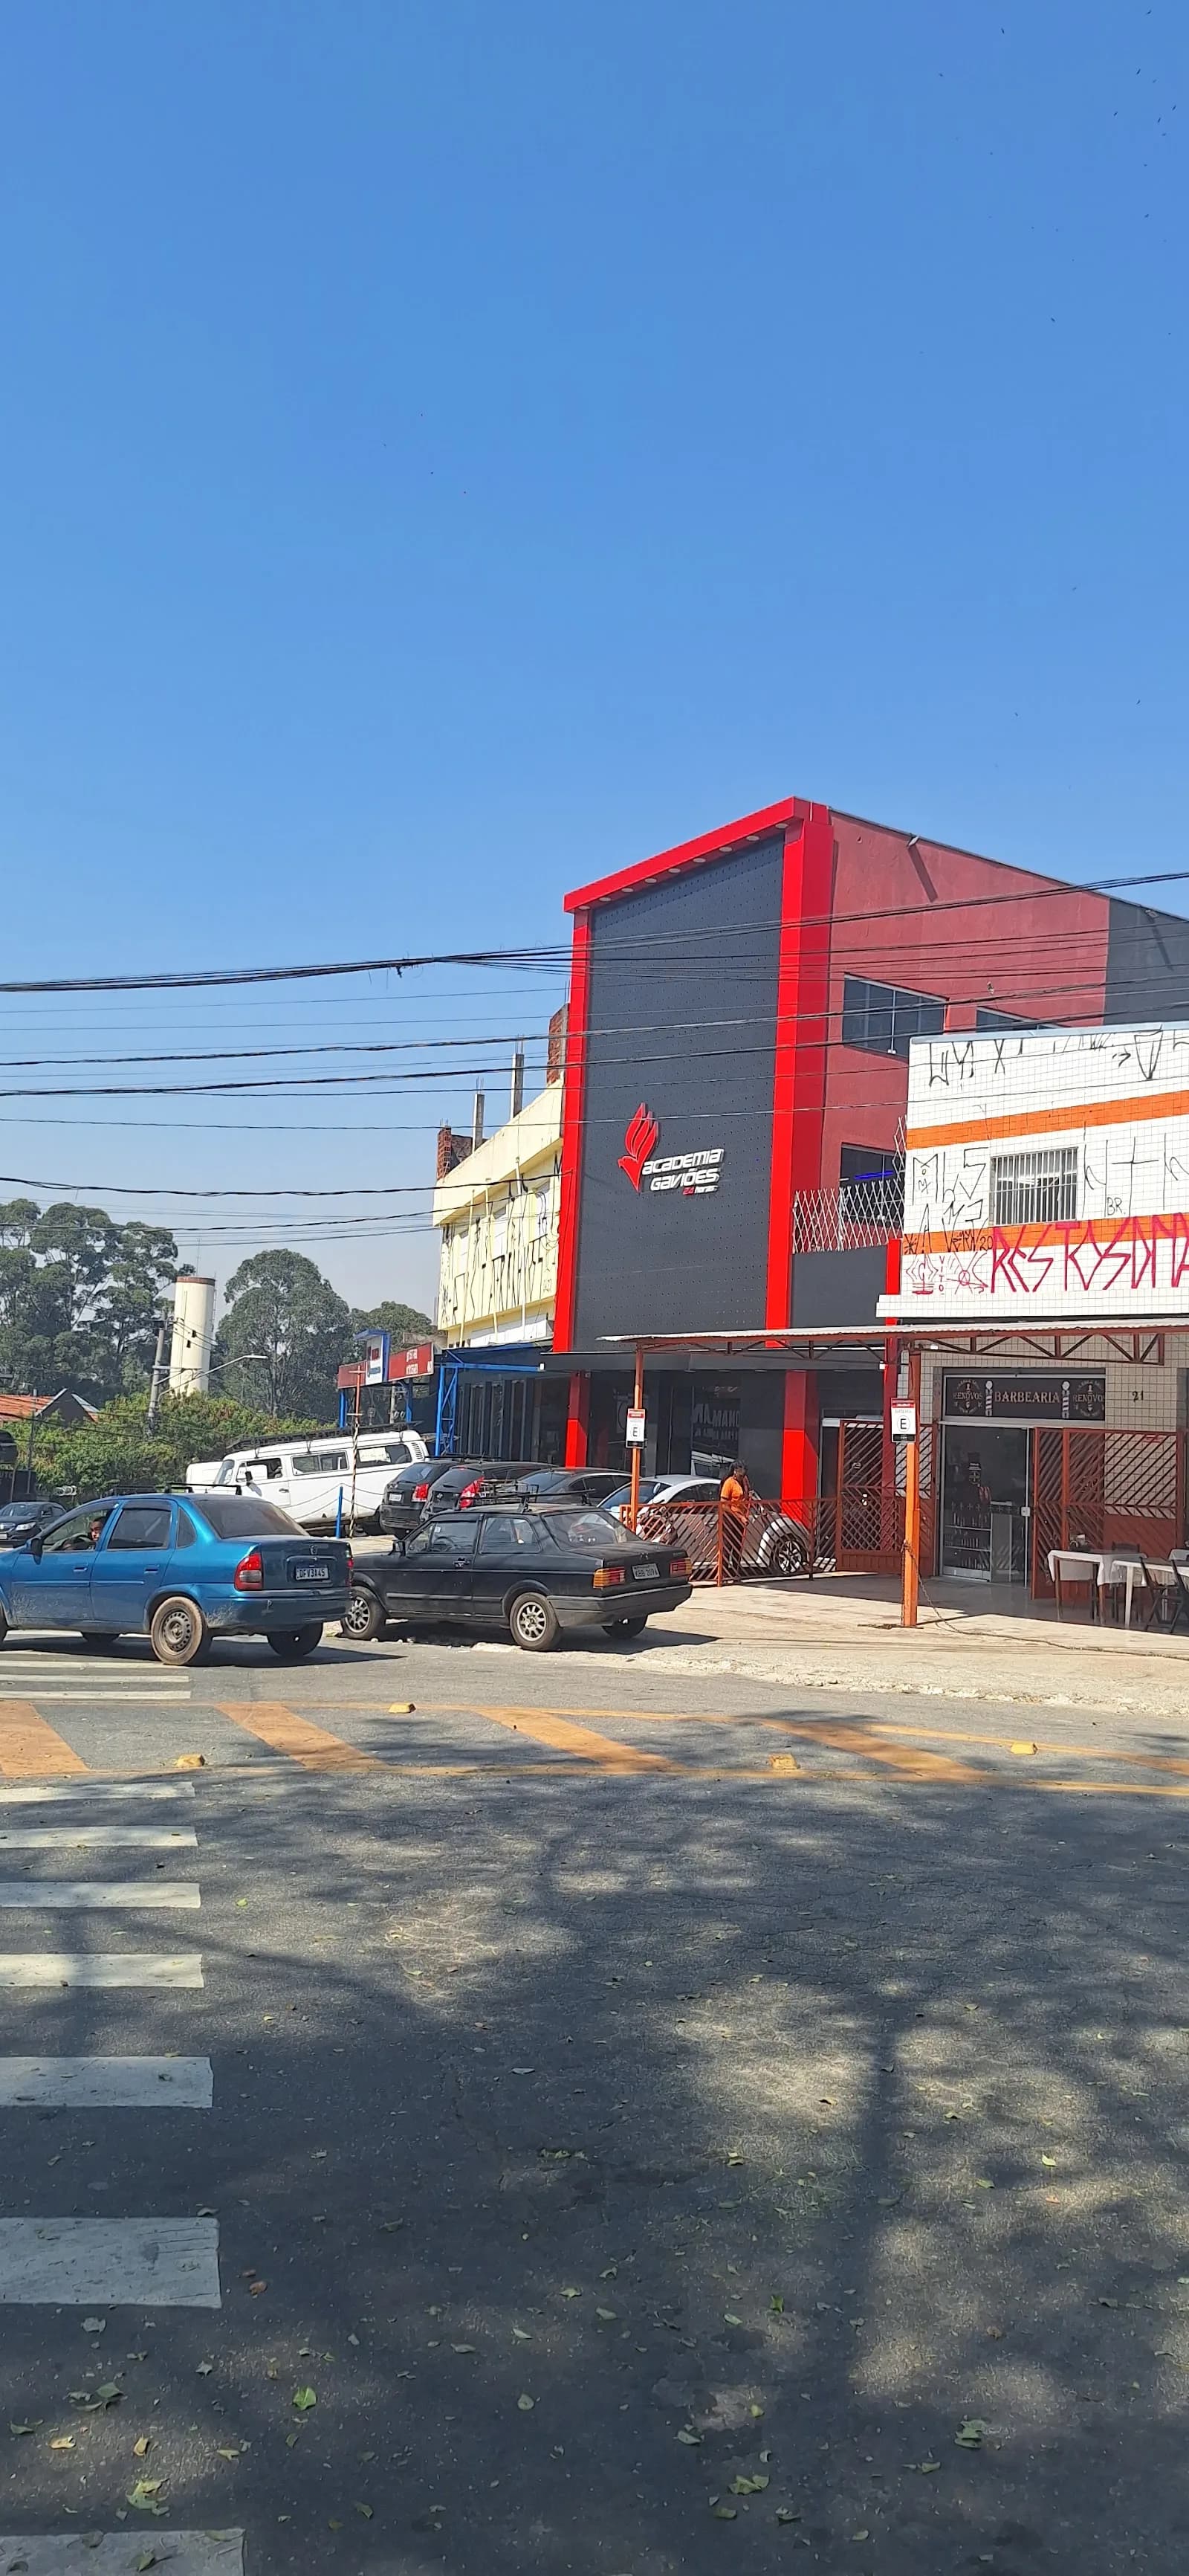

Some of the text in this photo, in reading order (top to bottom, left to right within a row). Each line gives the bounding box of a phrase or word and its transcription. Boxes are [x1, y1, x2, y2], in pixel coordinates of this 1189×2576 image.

[994, 1391, 1060, 1404] BARBEARIA
[1132, 1390, 1144, 1402] 21
[900, 1418, 907, 1430] E
[632, 1427, 638, 1437] E
